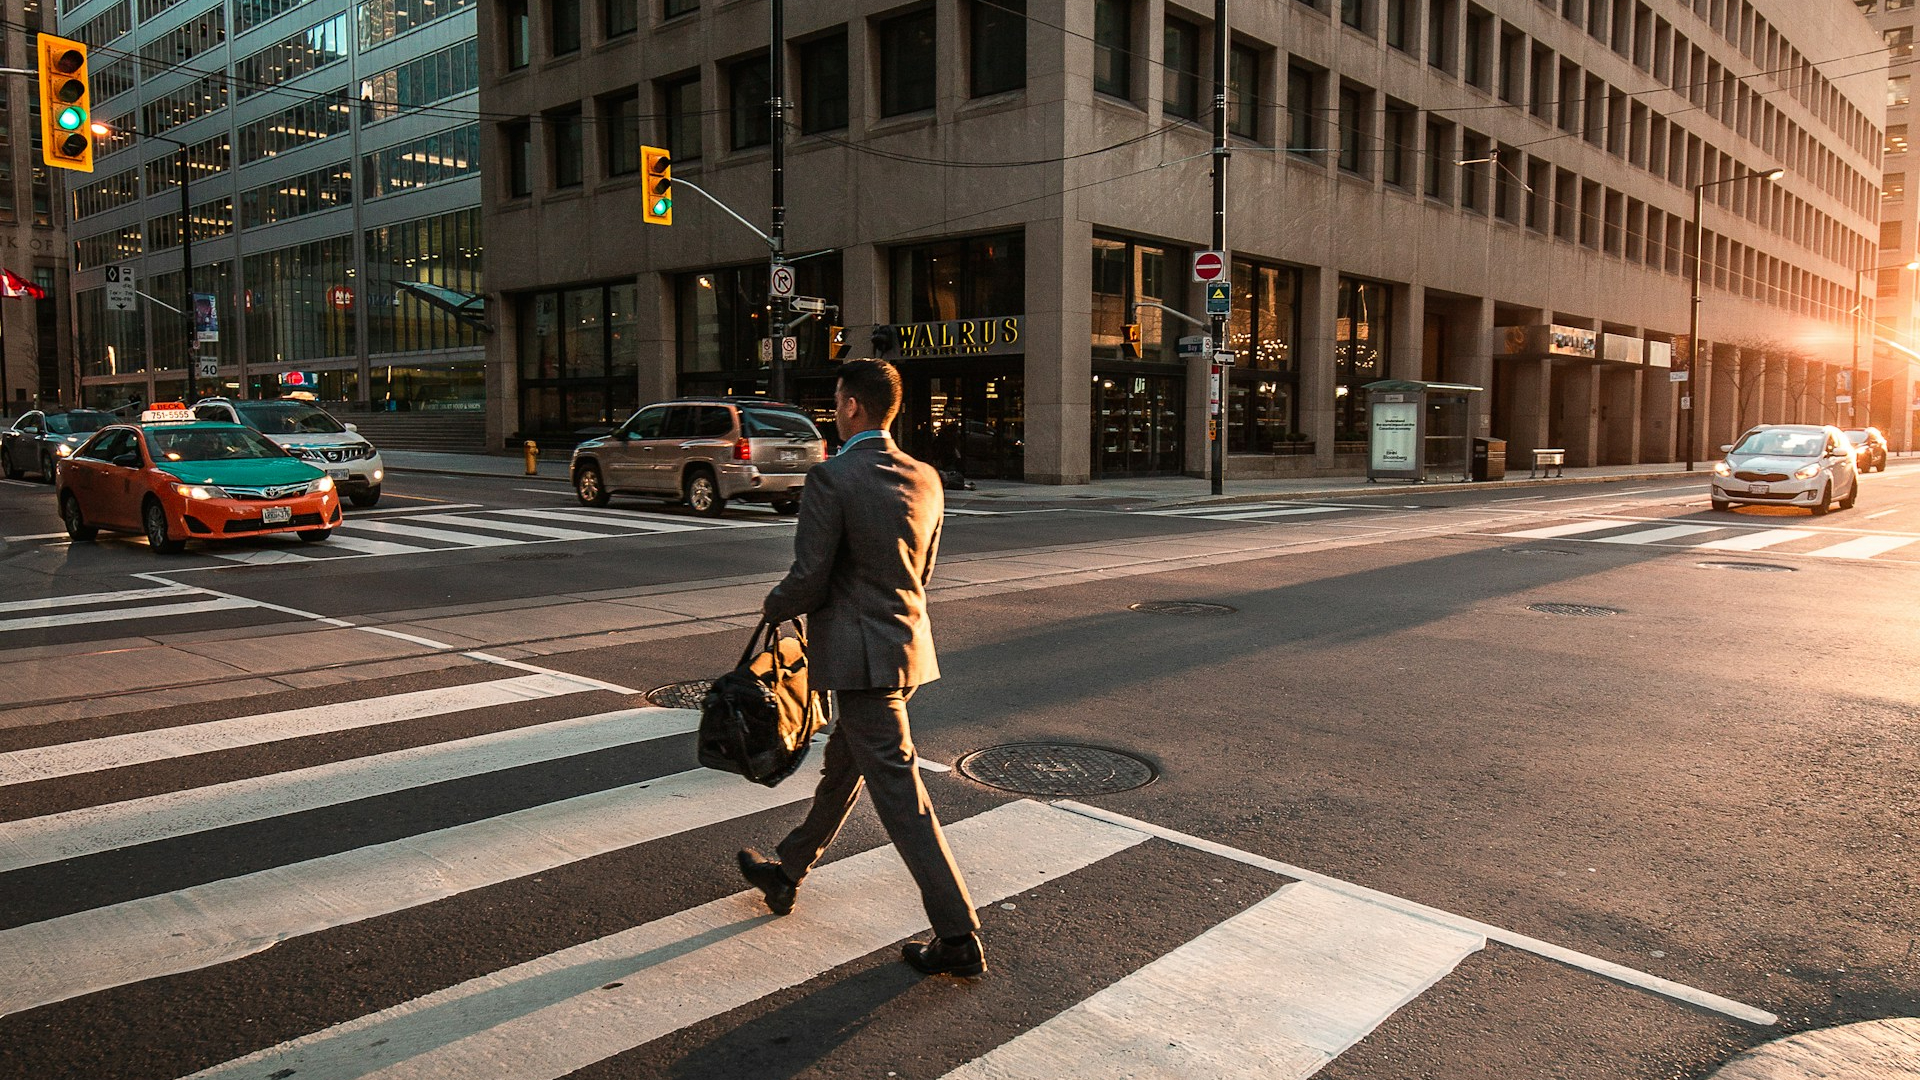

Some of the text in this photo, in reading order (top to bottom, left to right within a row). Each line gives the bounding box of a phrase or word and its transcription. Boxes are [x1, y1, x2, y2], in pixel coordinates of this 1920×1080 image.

[0, 235, 54, 251] K OF
[896, 318, 1018, 349] WALRUS
[1187, 344, 1198, 353] Bay
[202, 364, 217, 376] 40
[157, 403, 180, 411] BECK
[151, 410, 190, 419] 751-5555
